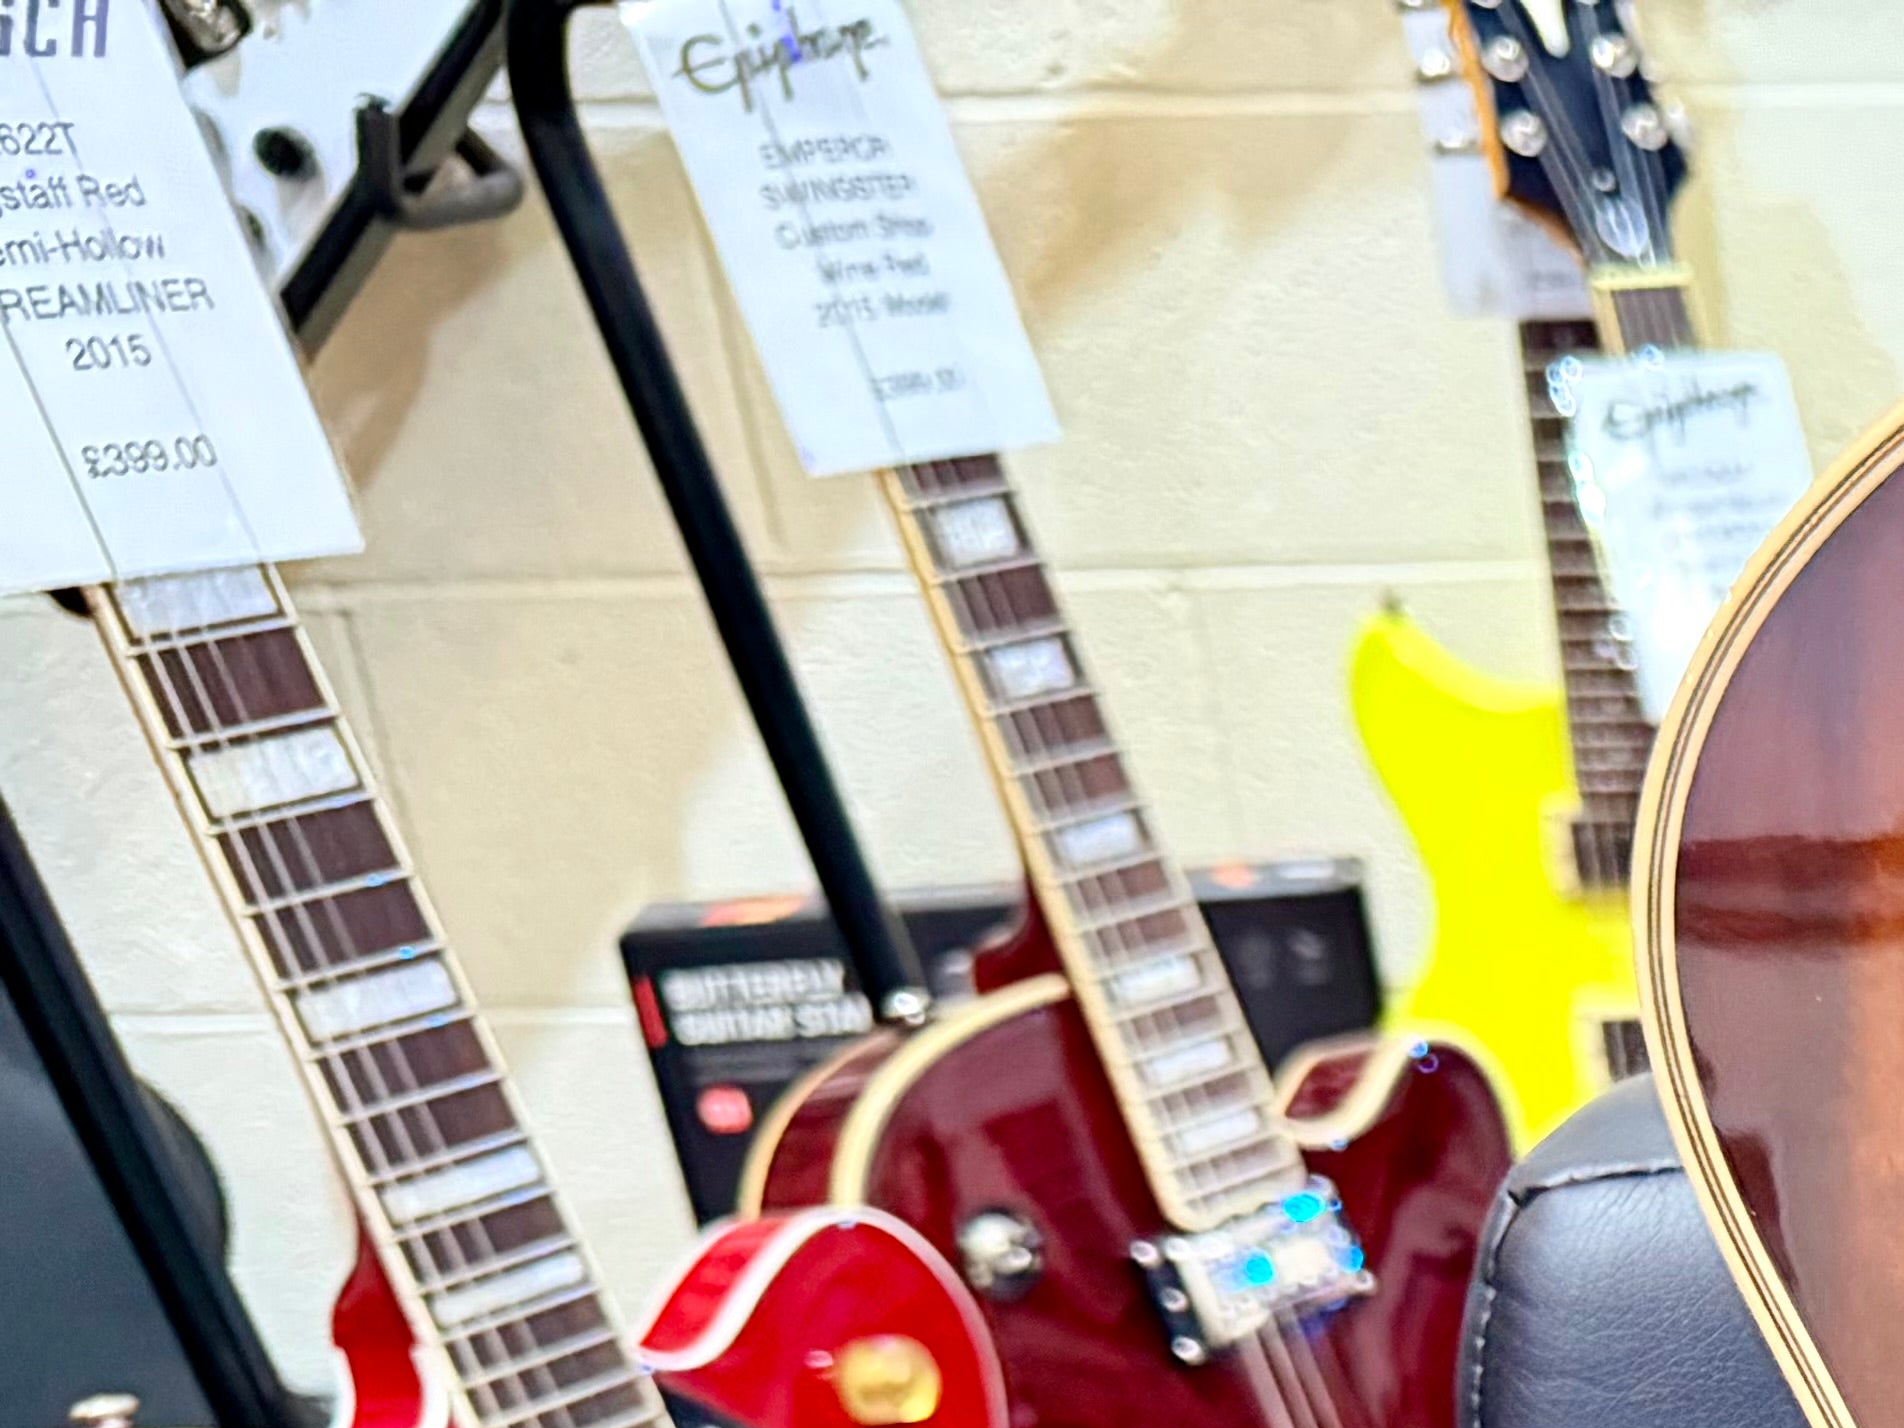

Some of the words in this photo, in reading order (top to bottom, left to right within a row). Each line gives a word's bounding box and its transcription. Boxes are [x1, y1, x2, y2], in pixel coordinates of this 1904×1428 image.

[0, 174, 72, 218] staff
[76, 173, 148, 208] Red
[66, 334, 152, 372] 2015
[81, 433, 218, 480] £399.00
